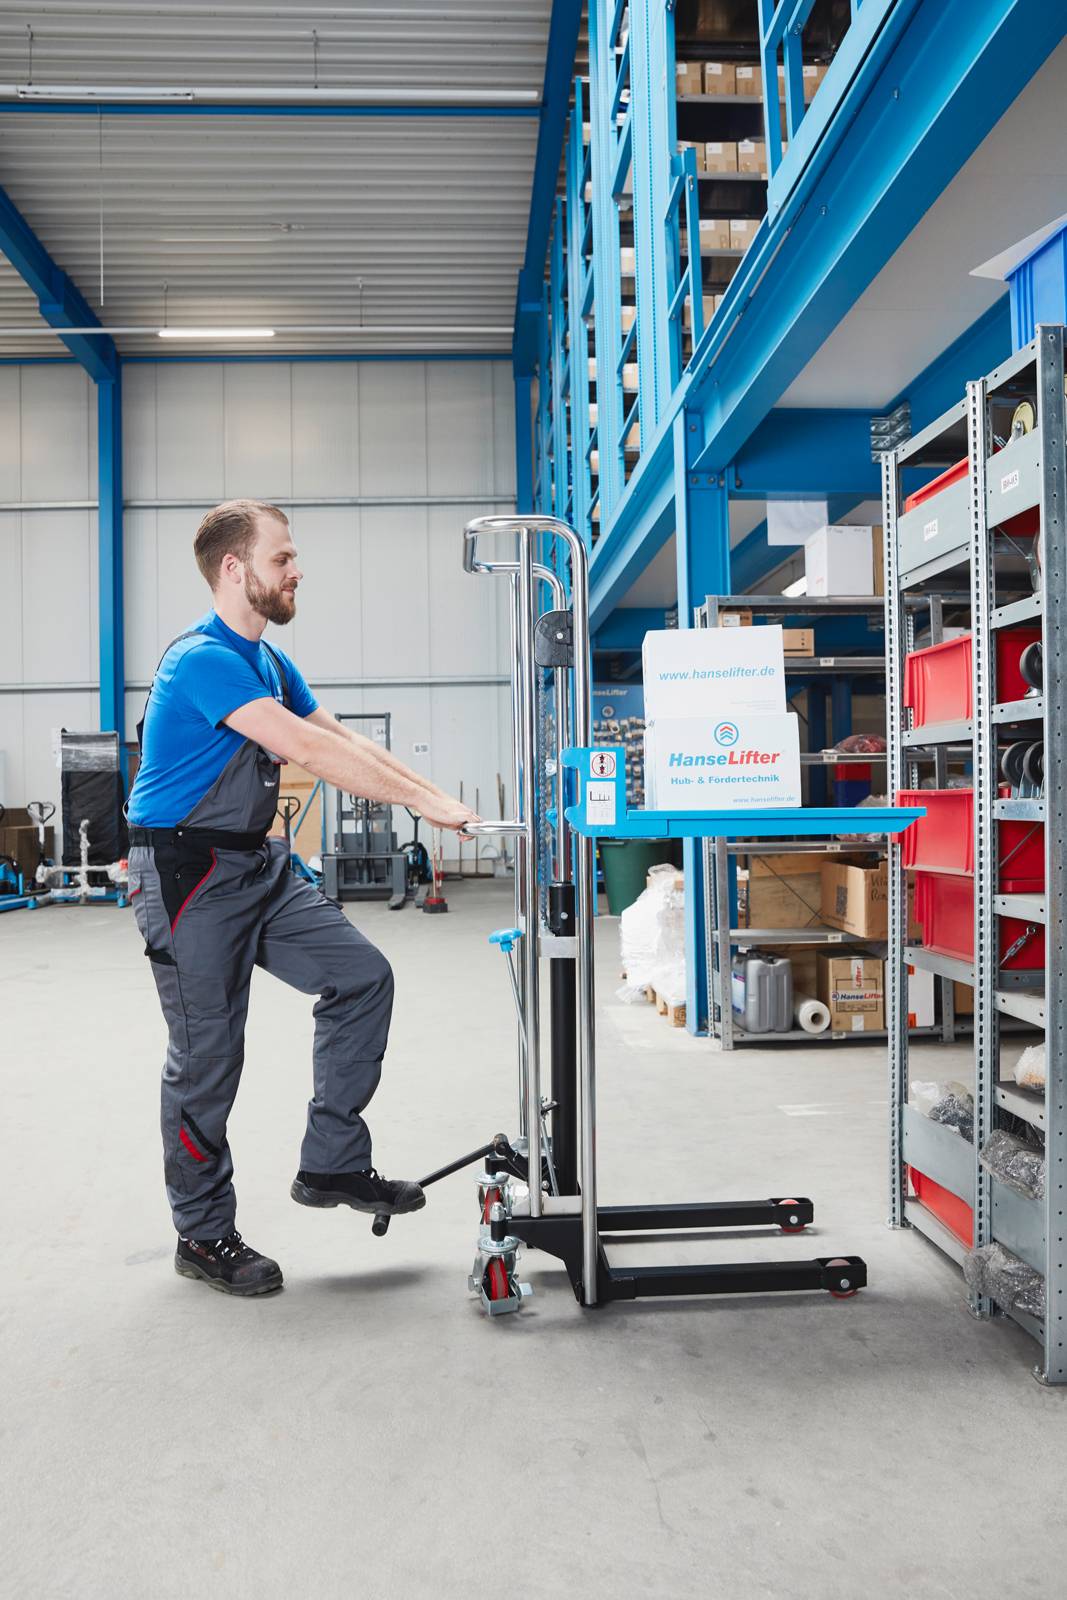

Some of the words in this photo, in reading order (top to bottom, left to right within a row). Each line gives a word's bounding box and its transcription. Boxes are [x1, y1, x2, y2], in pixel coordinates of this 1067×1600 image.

[659, 665, 776, 681] www.hanselifter.de
[592, 689, 628, 697] nseLifter
[668, 750, 781, 767] HanseLifter
[670, 776, 694, 785] Hub-
[697, 776, 705, 785] &
